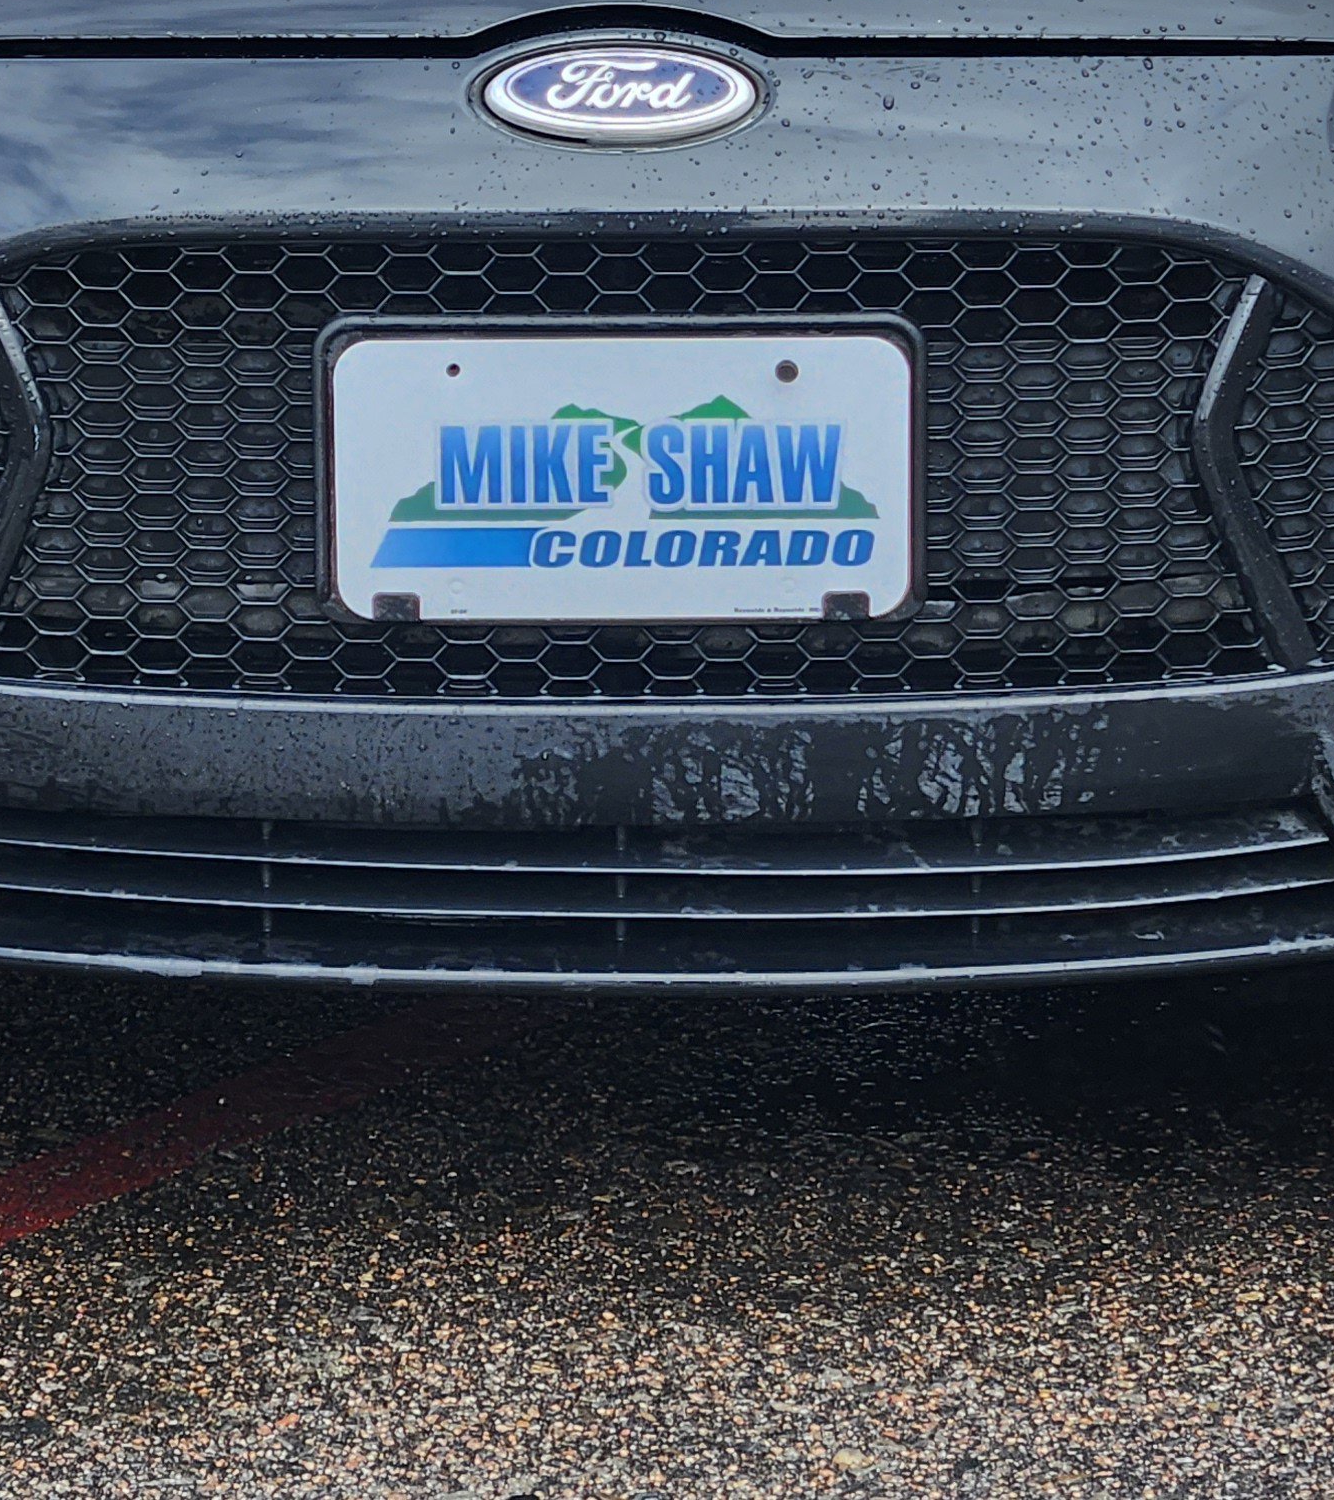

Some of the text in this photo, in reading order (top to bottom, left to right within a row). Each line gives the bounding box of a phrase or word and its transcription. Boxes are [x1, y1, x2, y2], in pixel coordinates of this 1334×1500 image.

[547, 60, 695, 109] Ford
[439, 423, 841, 505] MIKE SHAW
[533, 529, 875, 568] COLORADO
